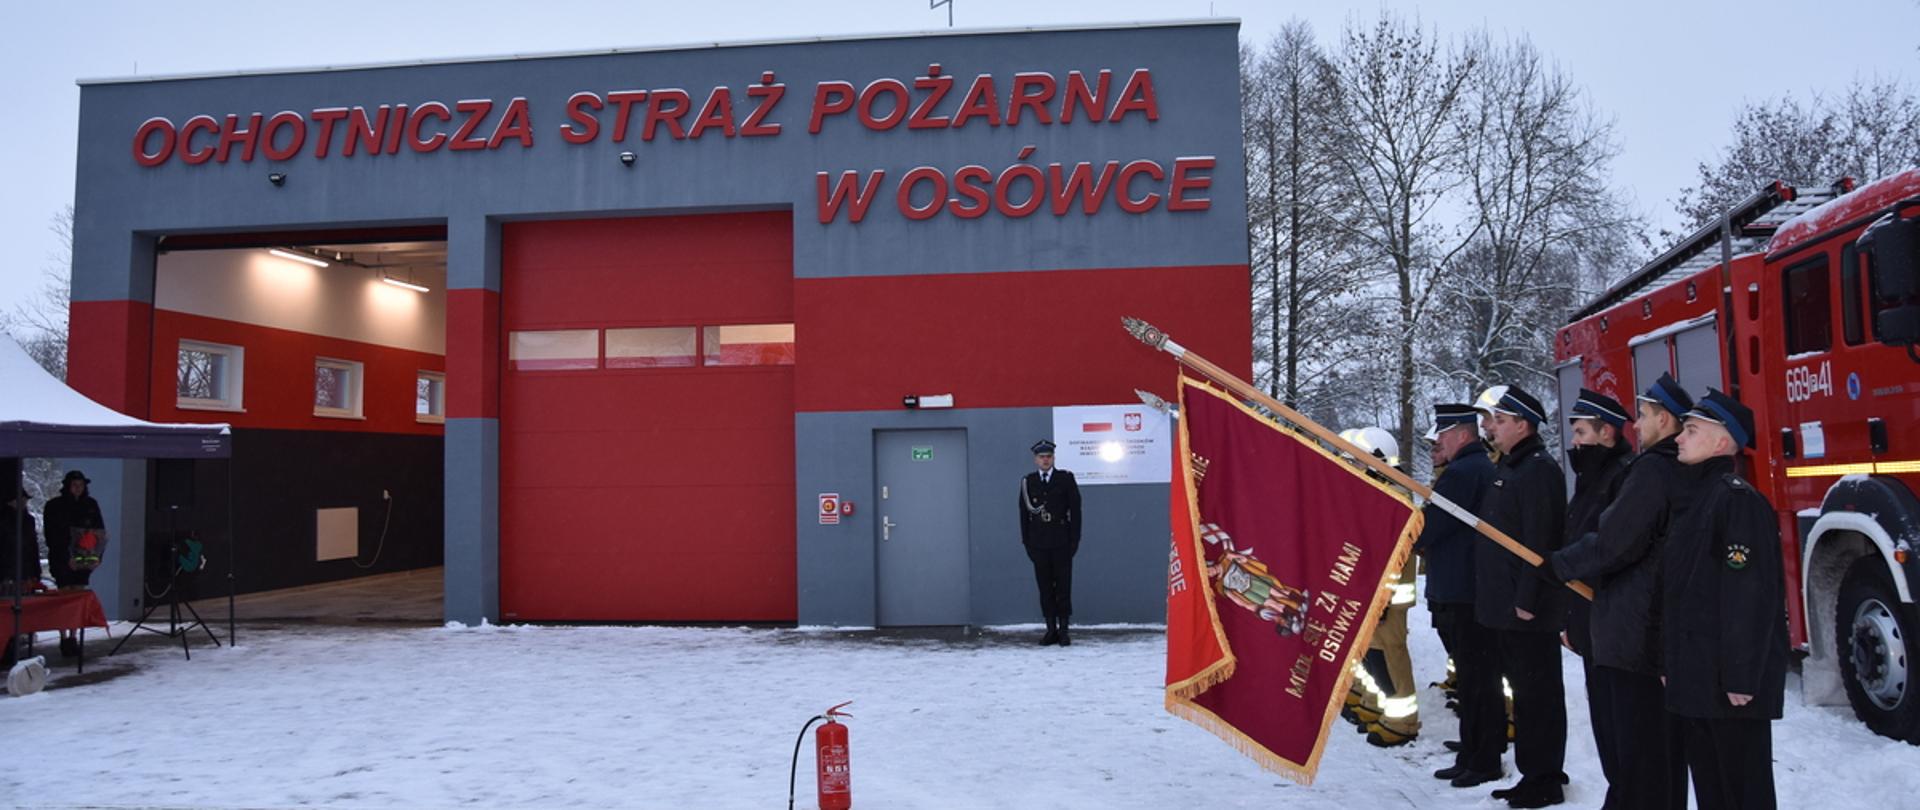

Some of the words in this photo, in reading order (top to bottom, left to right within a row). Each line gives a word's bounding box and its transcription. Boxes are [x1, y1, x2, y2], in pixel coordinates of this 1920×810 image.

[132, 96, 534, 168] OCHOTNICZA
[560, 70, 785, 144] STRAŻ
[808, 63, 1160, 134] POŻARNA
[816, 169, 885, 224] W
[897, 145, 1216, 220] OSÓWCE
[1315, 590, 1340, 614] ZA
[1329, 541, 1363, 587] NAMI
